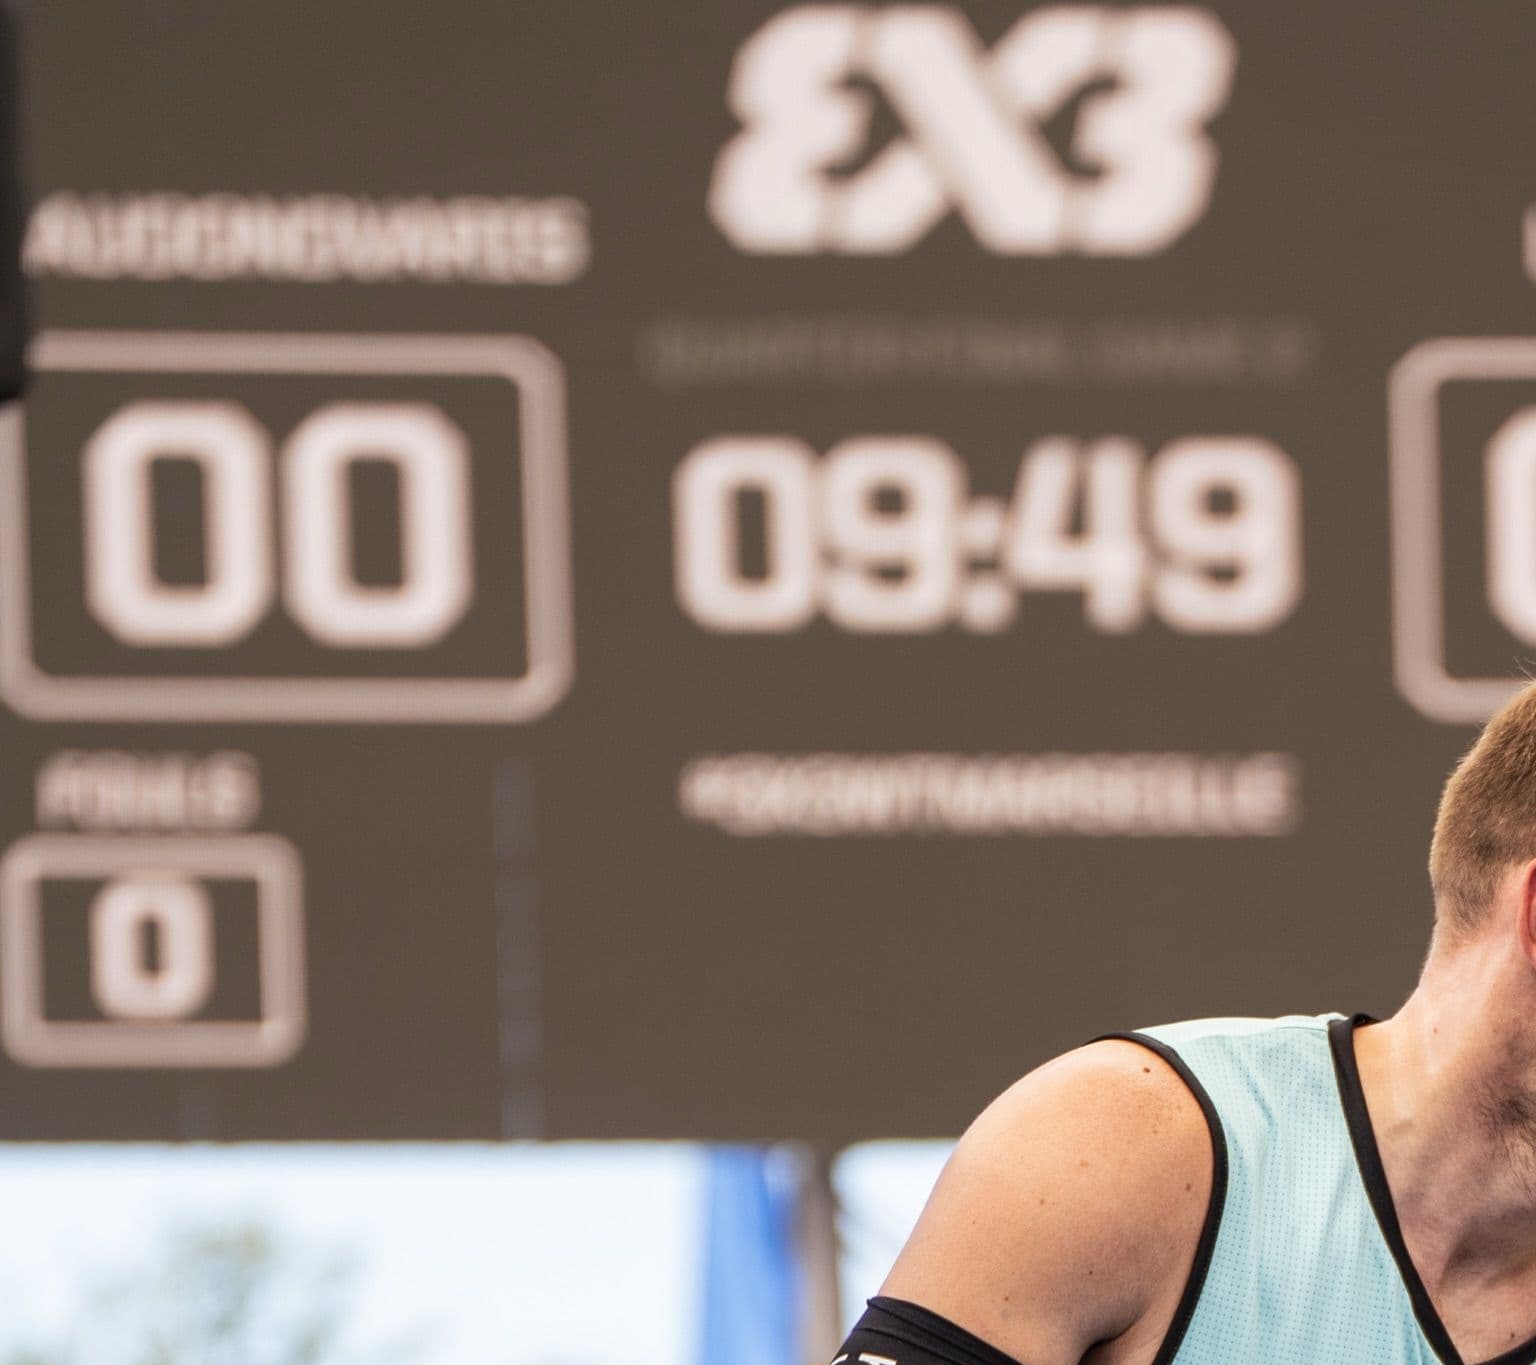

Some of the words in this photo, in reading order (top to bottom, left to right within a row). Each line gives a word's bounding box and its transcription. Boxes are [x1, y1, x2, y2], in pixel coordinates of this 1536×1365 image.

[82, 400, 474, 647] 00
[673, 437, 1303, 634] 09:49
[90, 873, 214, 1022] 0
